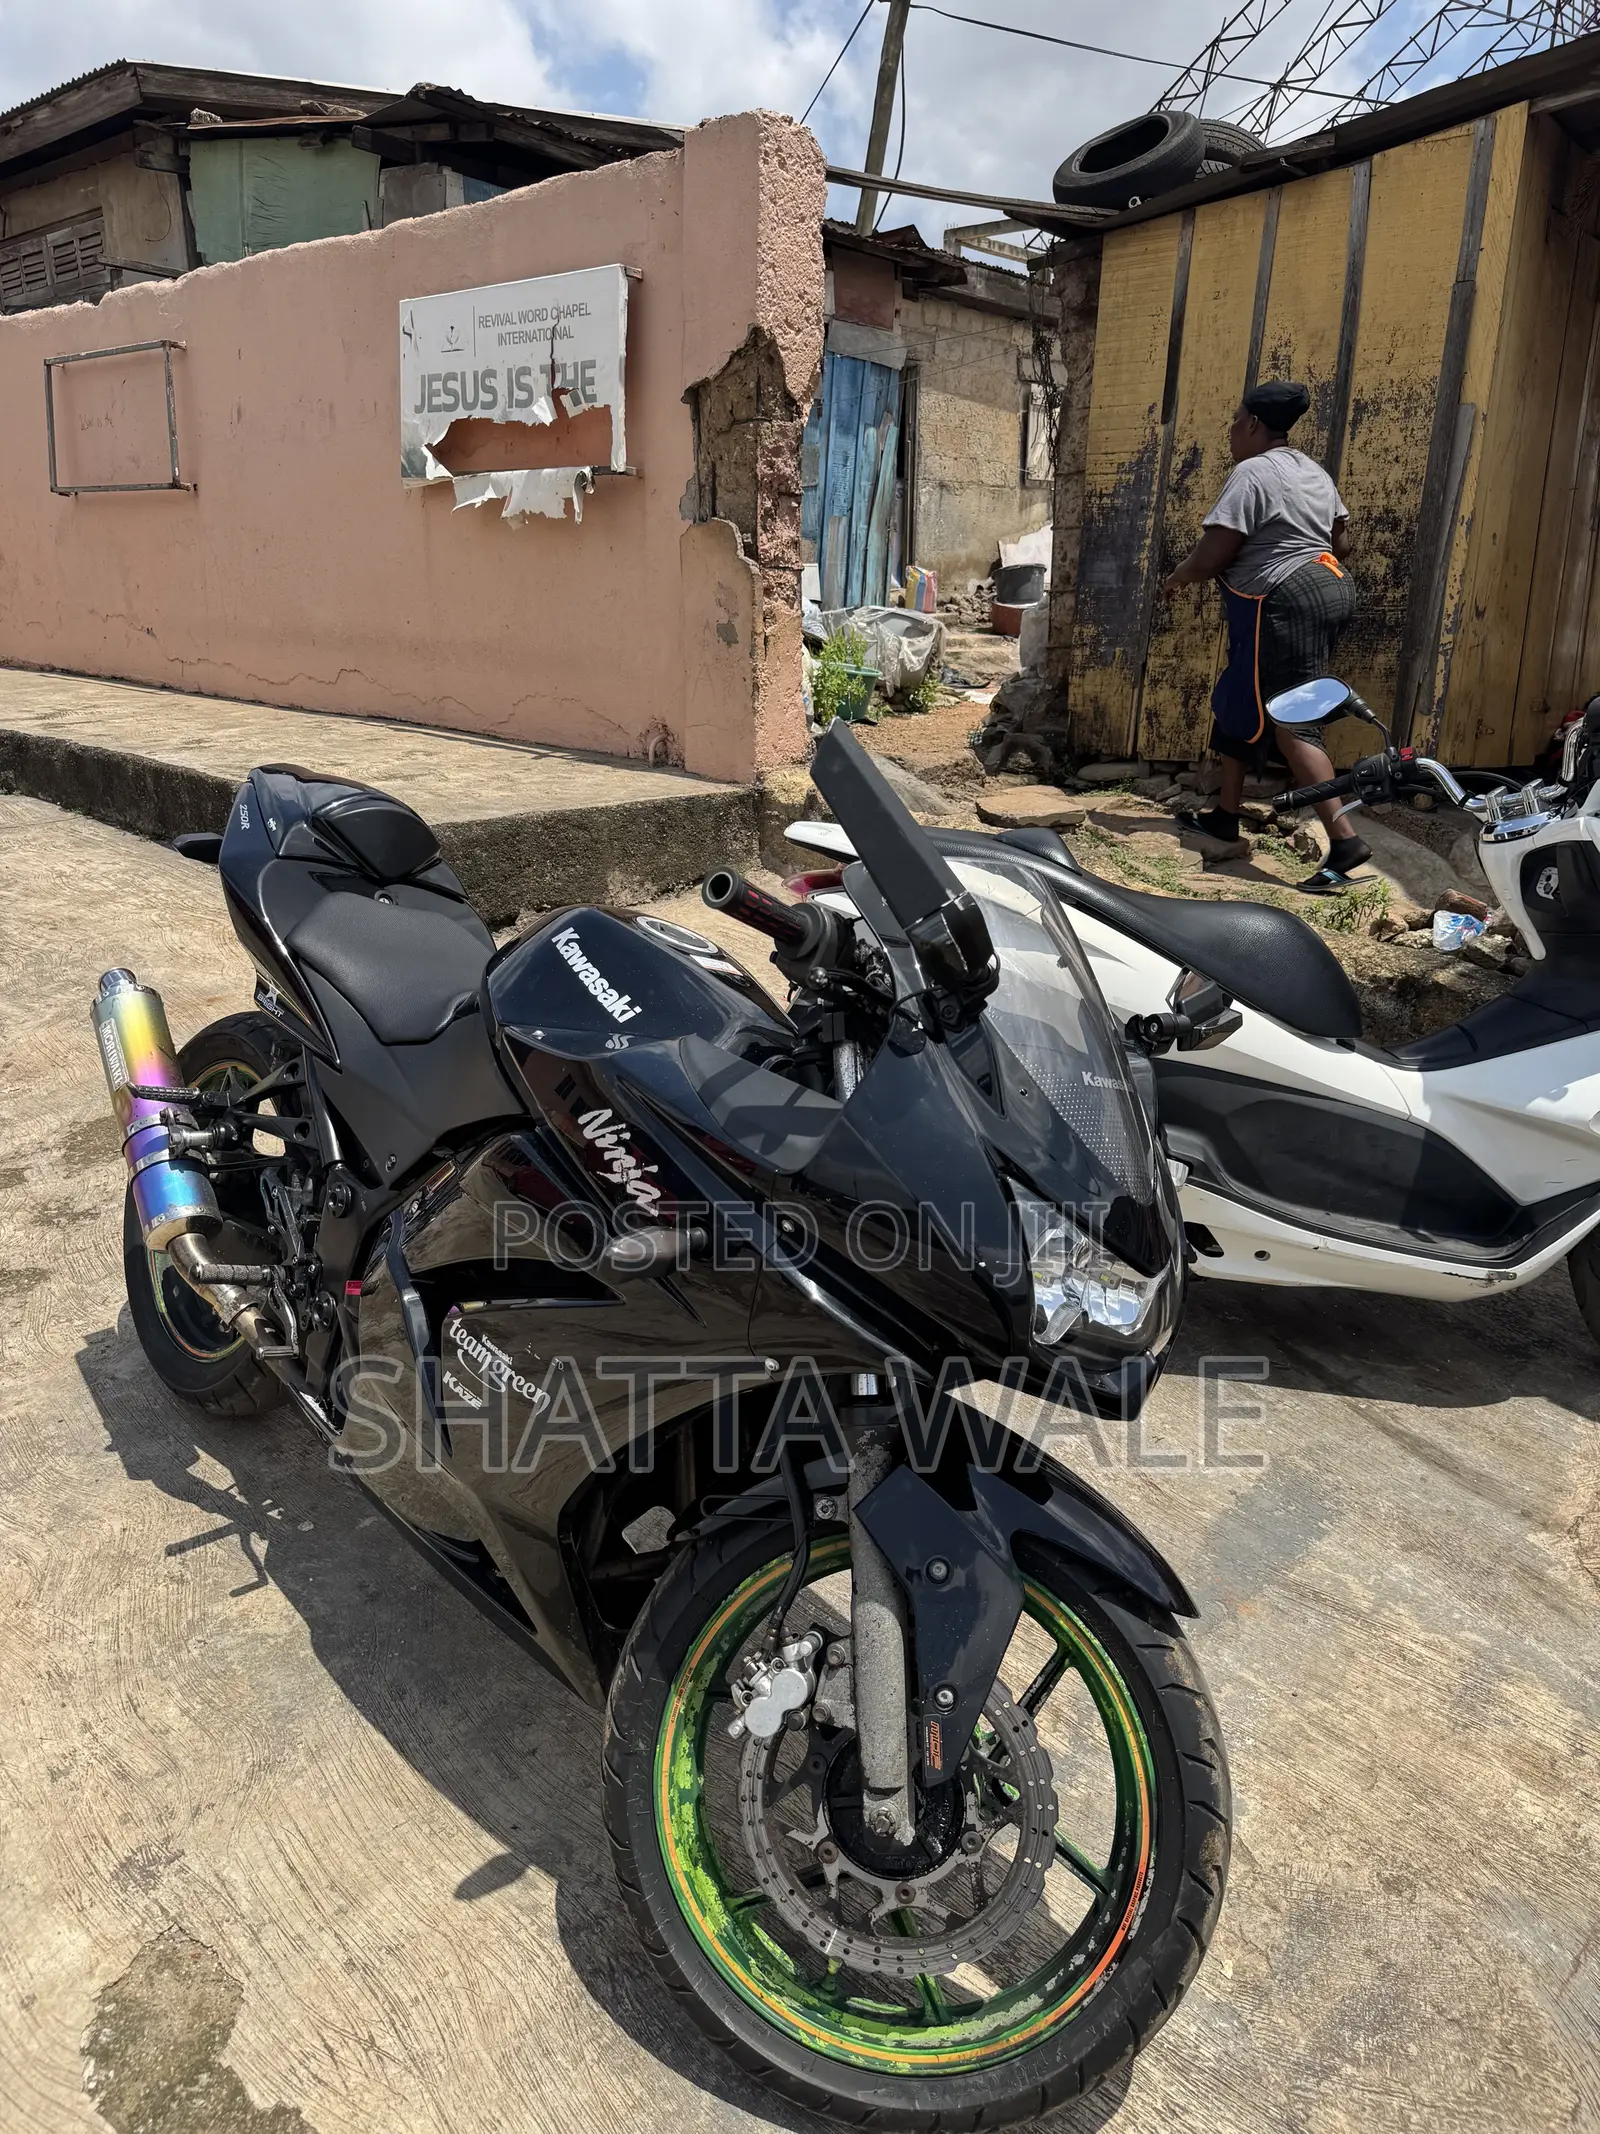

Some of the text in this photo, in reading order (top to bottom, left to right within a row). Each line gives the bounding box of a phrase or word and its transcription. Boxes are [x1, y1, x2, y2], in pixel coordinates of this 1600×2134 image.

[478, 302, 592, 328] REVIVAL WORD CHAPEL
[497, 325, 575, 347] INTERNATIONAL
[413, 359, 598, 415] JESUS IS THE
[239, 803, 250, 830] 250R
[551, 926, 643, 1024] Kawasaki
[101, 1024, 124, 1085] MORIWAKI
[577, 1108, 661, 1217] Ninja
[442, 1370, 483, 1410] KAZE
[449, 1317, 551, 1416] team green
